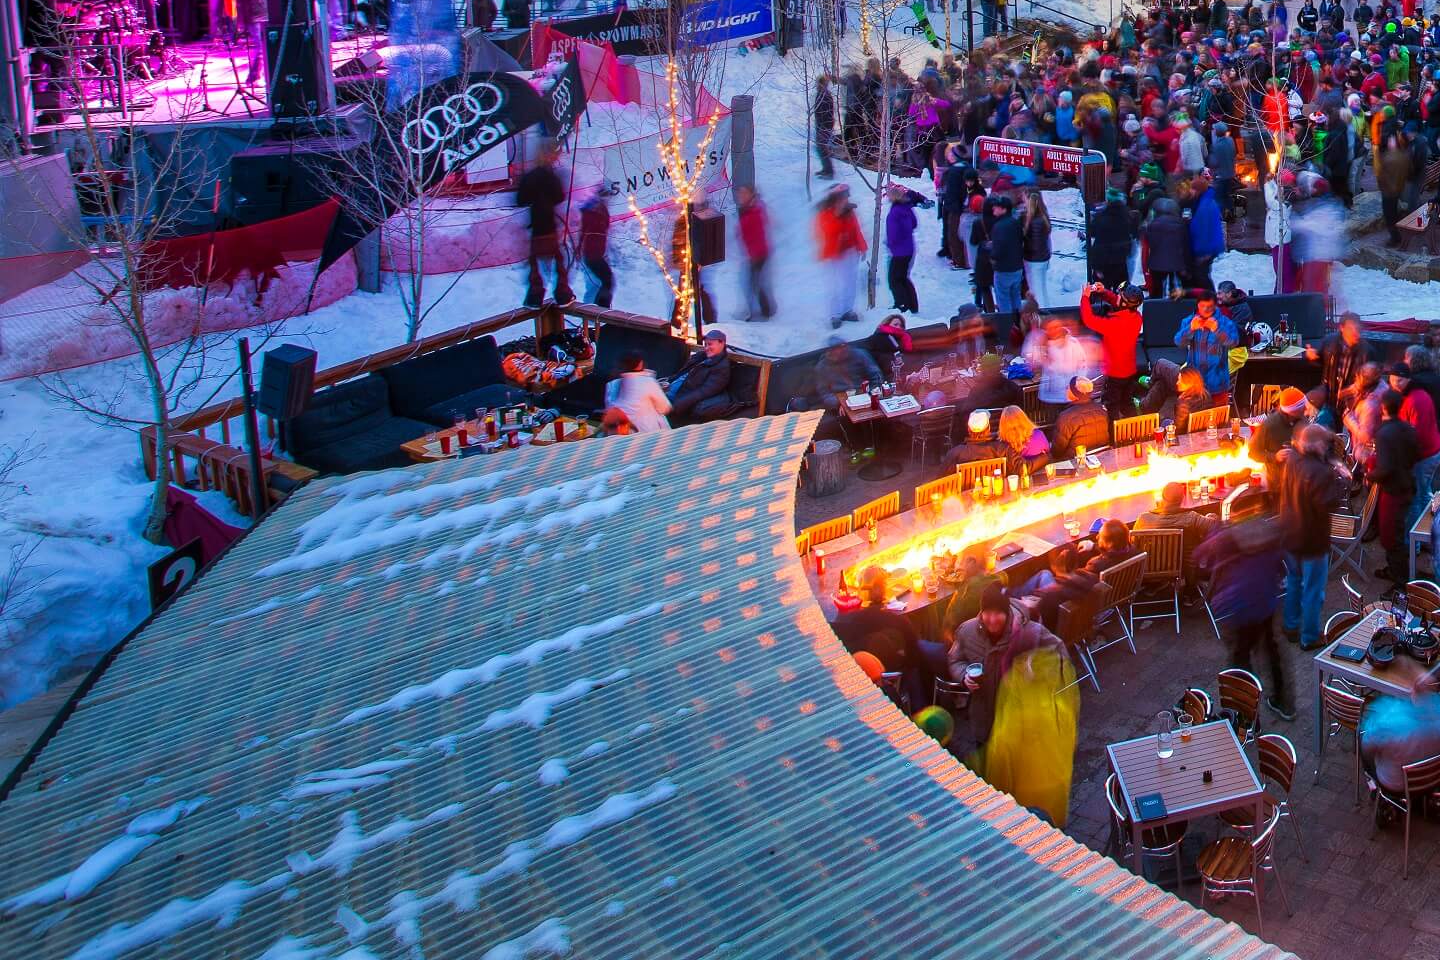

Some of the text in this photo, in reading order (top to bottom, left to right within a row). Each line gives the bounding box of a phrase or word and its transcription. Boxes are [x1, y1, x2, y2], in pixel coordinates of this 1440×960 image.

[716, 10, 760, 31] LIGHT
[443, 122, 508, 171] Audi
[983, 142, 1031, 156] ADULT SNOWBOARD
[989, 153, 1007, 163] LEVELS
[1046, 150, 1062, 161] ADULT
[1052, 161, 1071, 172] LEVELS
